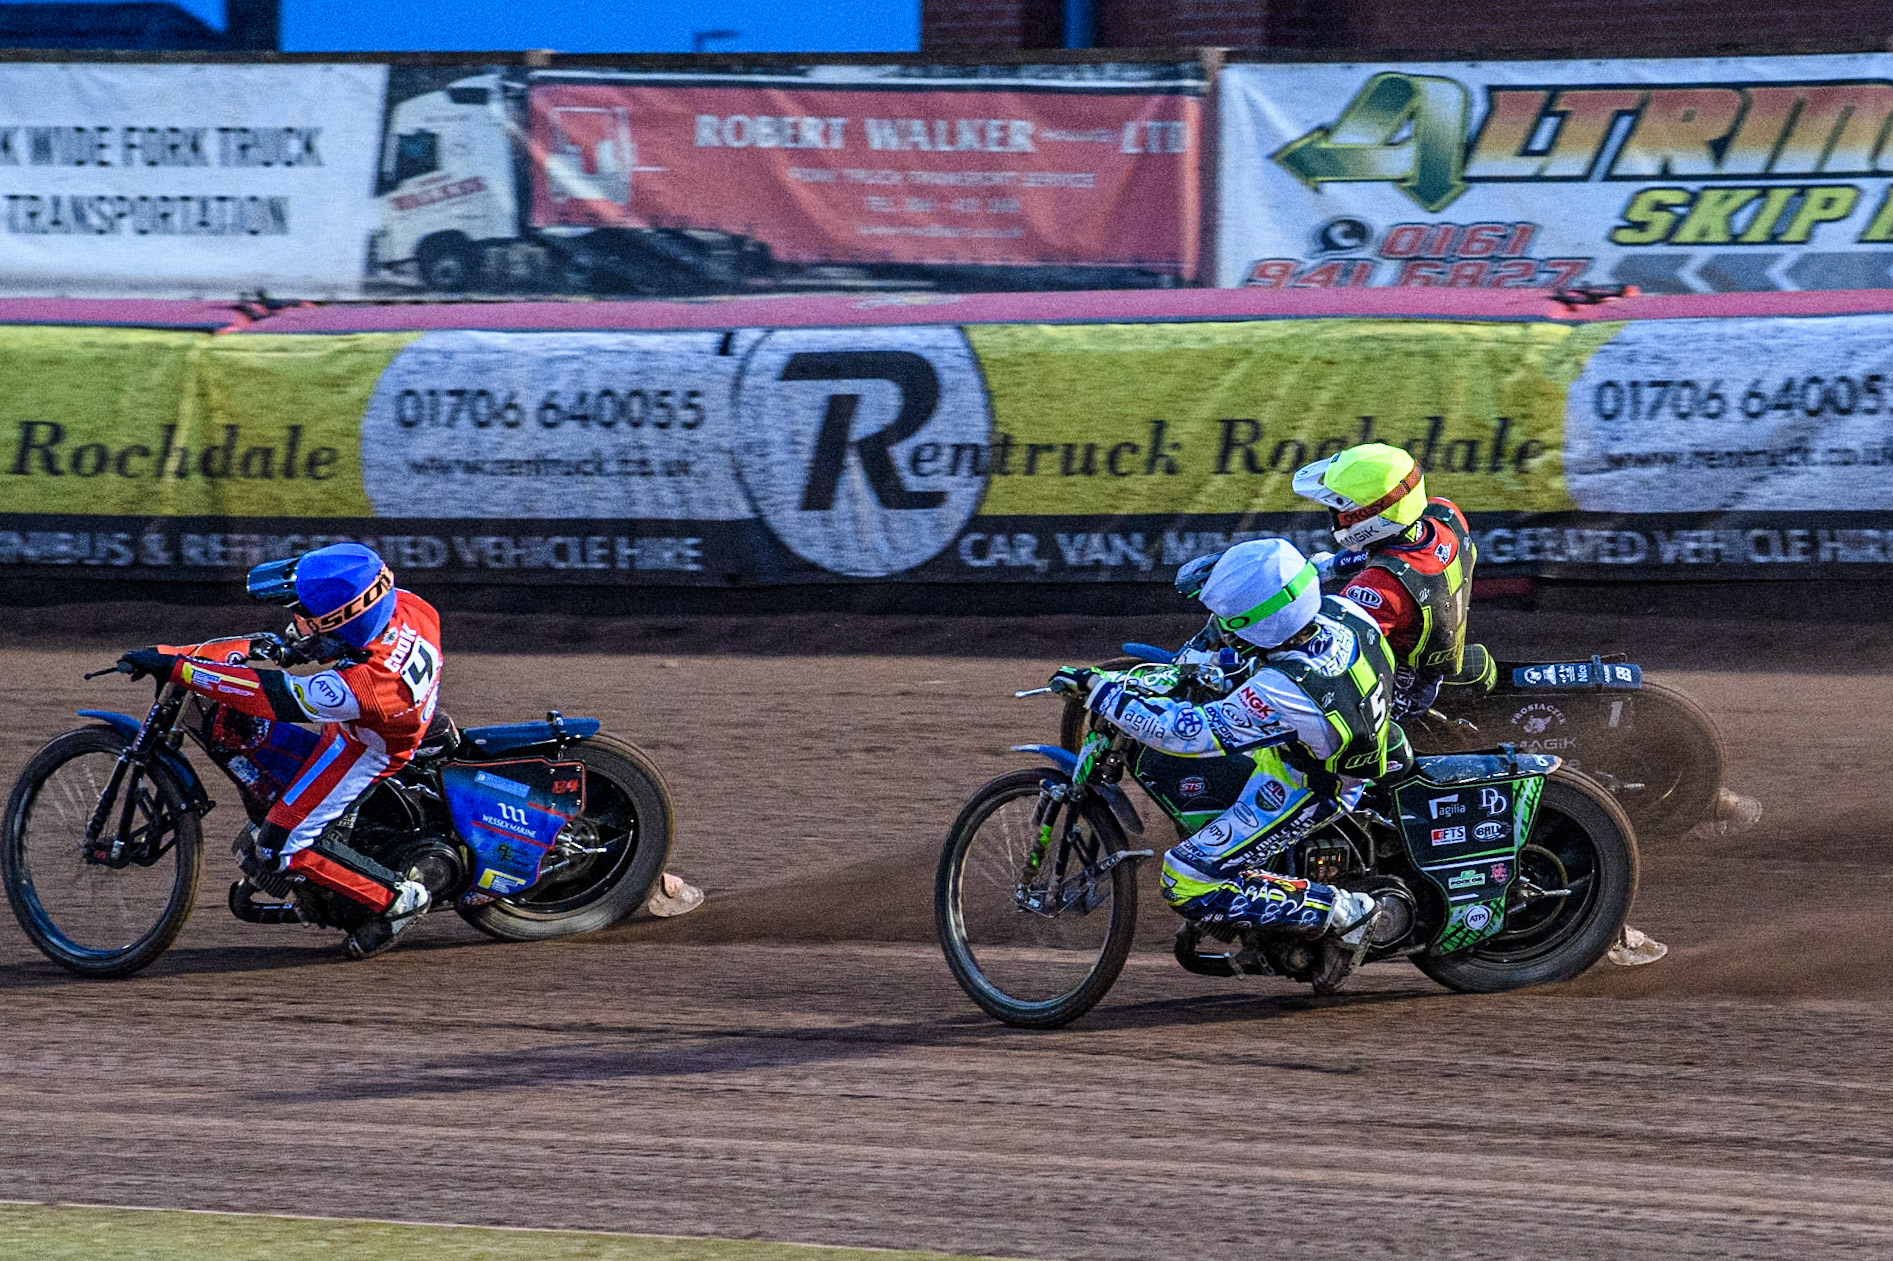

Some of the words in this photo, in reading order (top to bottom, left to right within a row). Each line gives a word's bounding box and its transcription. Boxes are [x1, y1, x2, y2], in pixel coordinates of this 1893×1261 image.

[28, 126, 112, 167] WIDE
[121, 126, 206, 167] FORK
[216, 126, 325, 167] TRUCK
[694, 114, 848, 149] ROBERT
[864, 117, 1037, 152] WALKER
[2, 194, 290, 236] TRANSPORTATION
[1611, 186, 1862, 247] SKIP
[1378, 221, 1543, 259] 0161
[397, 388, 523, 430] 01706
[537, 388, 705, 431] 640055
[1596, 378, 1727, 421] 01706
[1742, 373, 1893, 419] 64005
[4, 420, 340, 481] Rochdale
[453, 534, 609, 569] VEHICLE
[615, 536, 702, 571] HIRE
[384, 622, 418, 673] COOK
[315, 680, 340, 703] ATPI
[1240, 685, 1277, 719] NGK
[1124, 709, 1167, 740] agilia
[1608, 700, 1623, 728] 1
[1439, 803, 1466, 818] agilia
